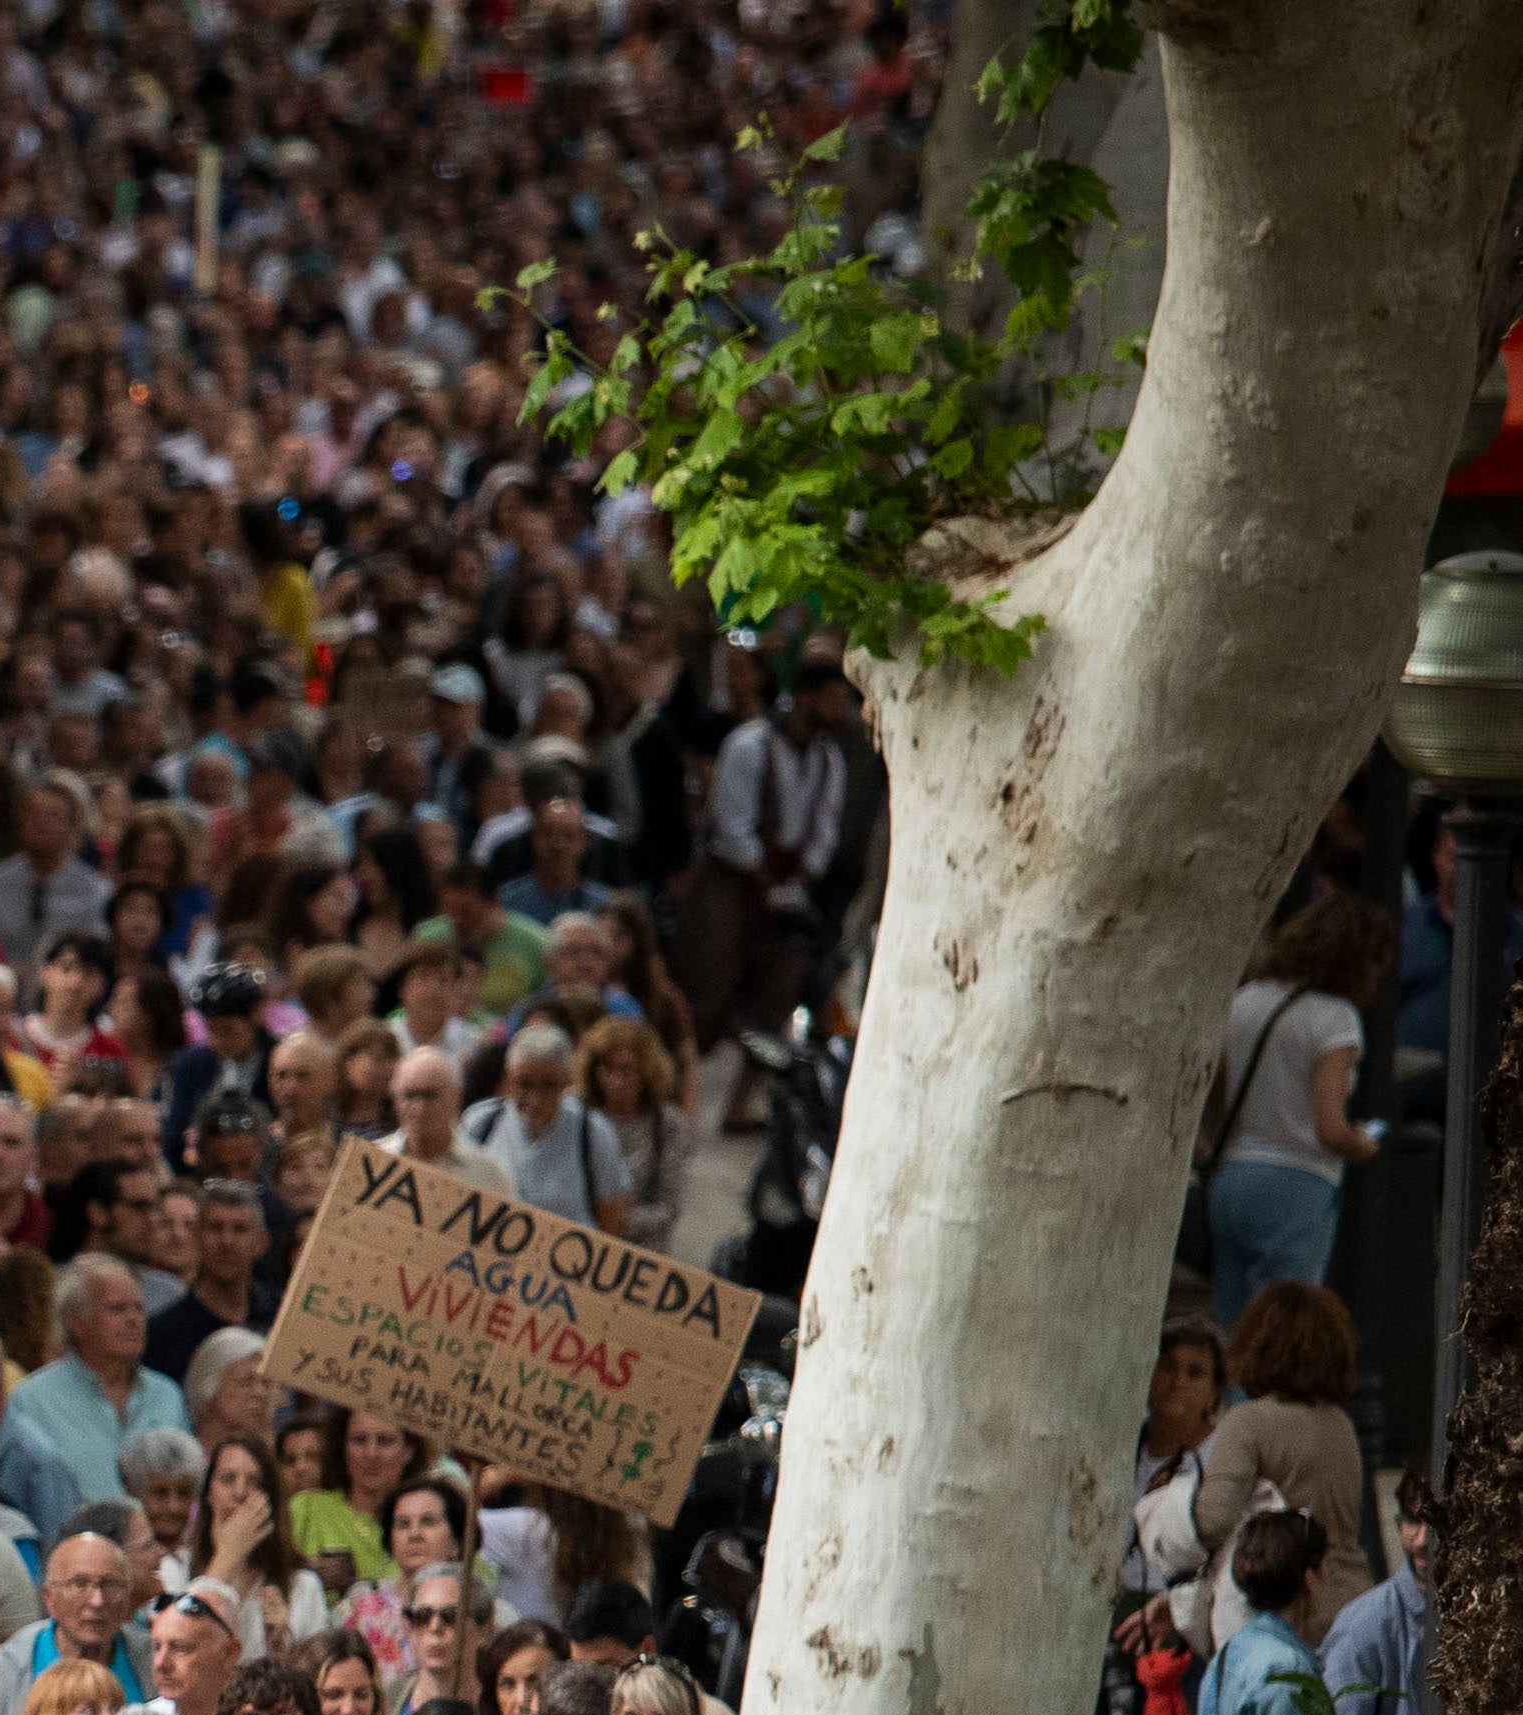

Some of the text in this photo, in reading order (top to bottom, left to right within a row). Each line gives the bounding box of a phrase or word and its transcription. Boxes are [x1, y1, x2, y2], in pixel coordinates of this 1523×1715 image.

[355, 1153, 722, 1340] YA NO QUEDA
[444, 1250, 577, 1323] AGUA
[349, 1336, 430, 1377] PARA
[398, 1266, 643, 1391] VIVIENDAS
[315, 1355, 375, 1393] SUS
[451, 1367, 595, 1440] MALLORCA
[517, 1360, 658, 1434] VITALES
[389, 1377, 587, 1478] HABITANTES
